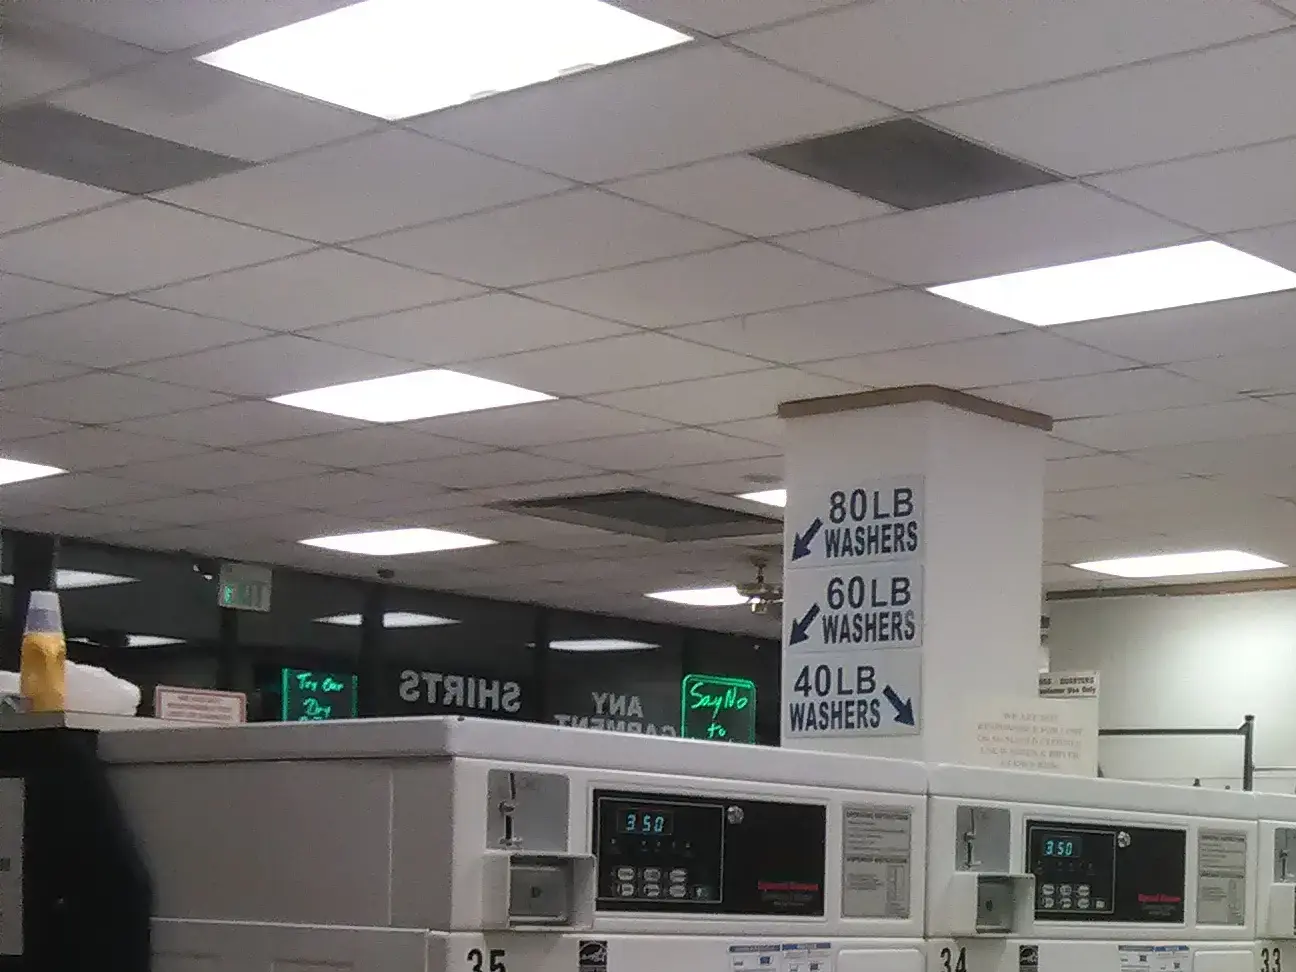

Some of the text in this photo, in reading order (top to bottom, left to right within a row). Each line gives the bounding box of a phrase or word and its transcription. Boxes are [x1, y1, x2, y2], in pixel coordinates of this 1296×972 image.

[829, 488, 914, 524] 80LB
[824, 520, 918, 559] WASHERS
[827, 576, 912, 610] 60LB
[822, 609, 916, 645] WASHERS
[296, 671, 318, 692] Try
[793, 664, 877, 698] 40LB
[303, 697, 332, 718] Dry
[690, 681, 749, 719] Say No
[788, 698, 881, 732] WASHERS
[707, 722, 727, 739] to
